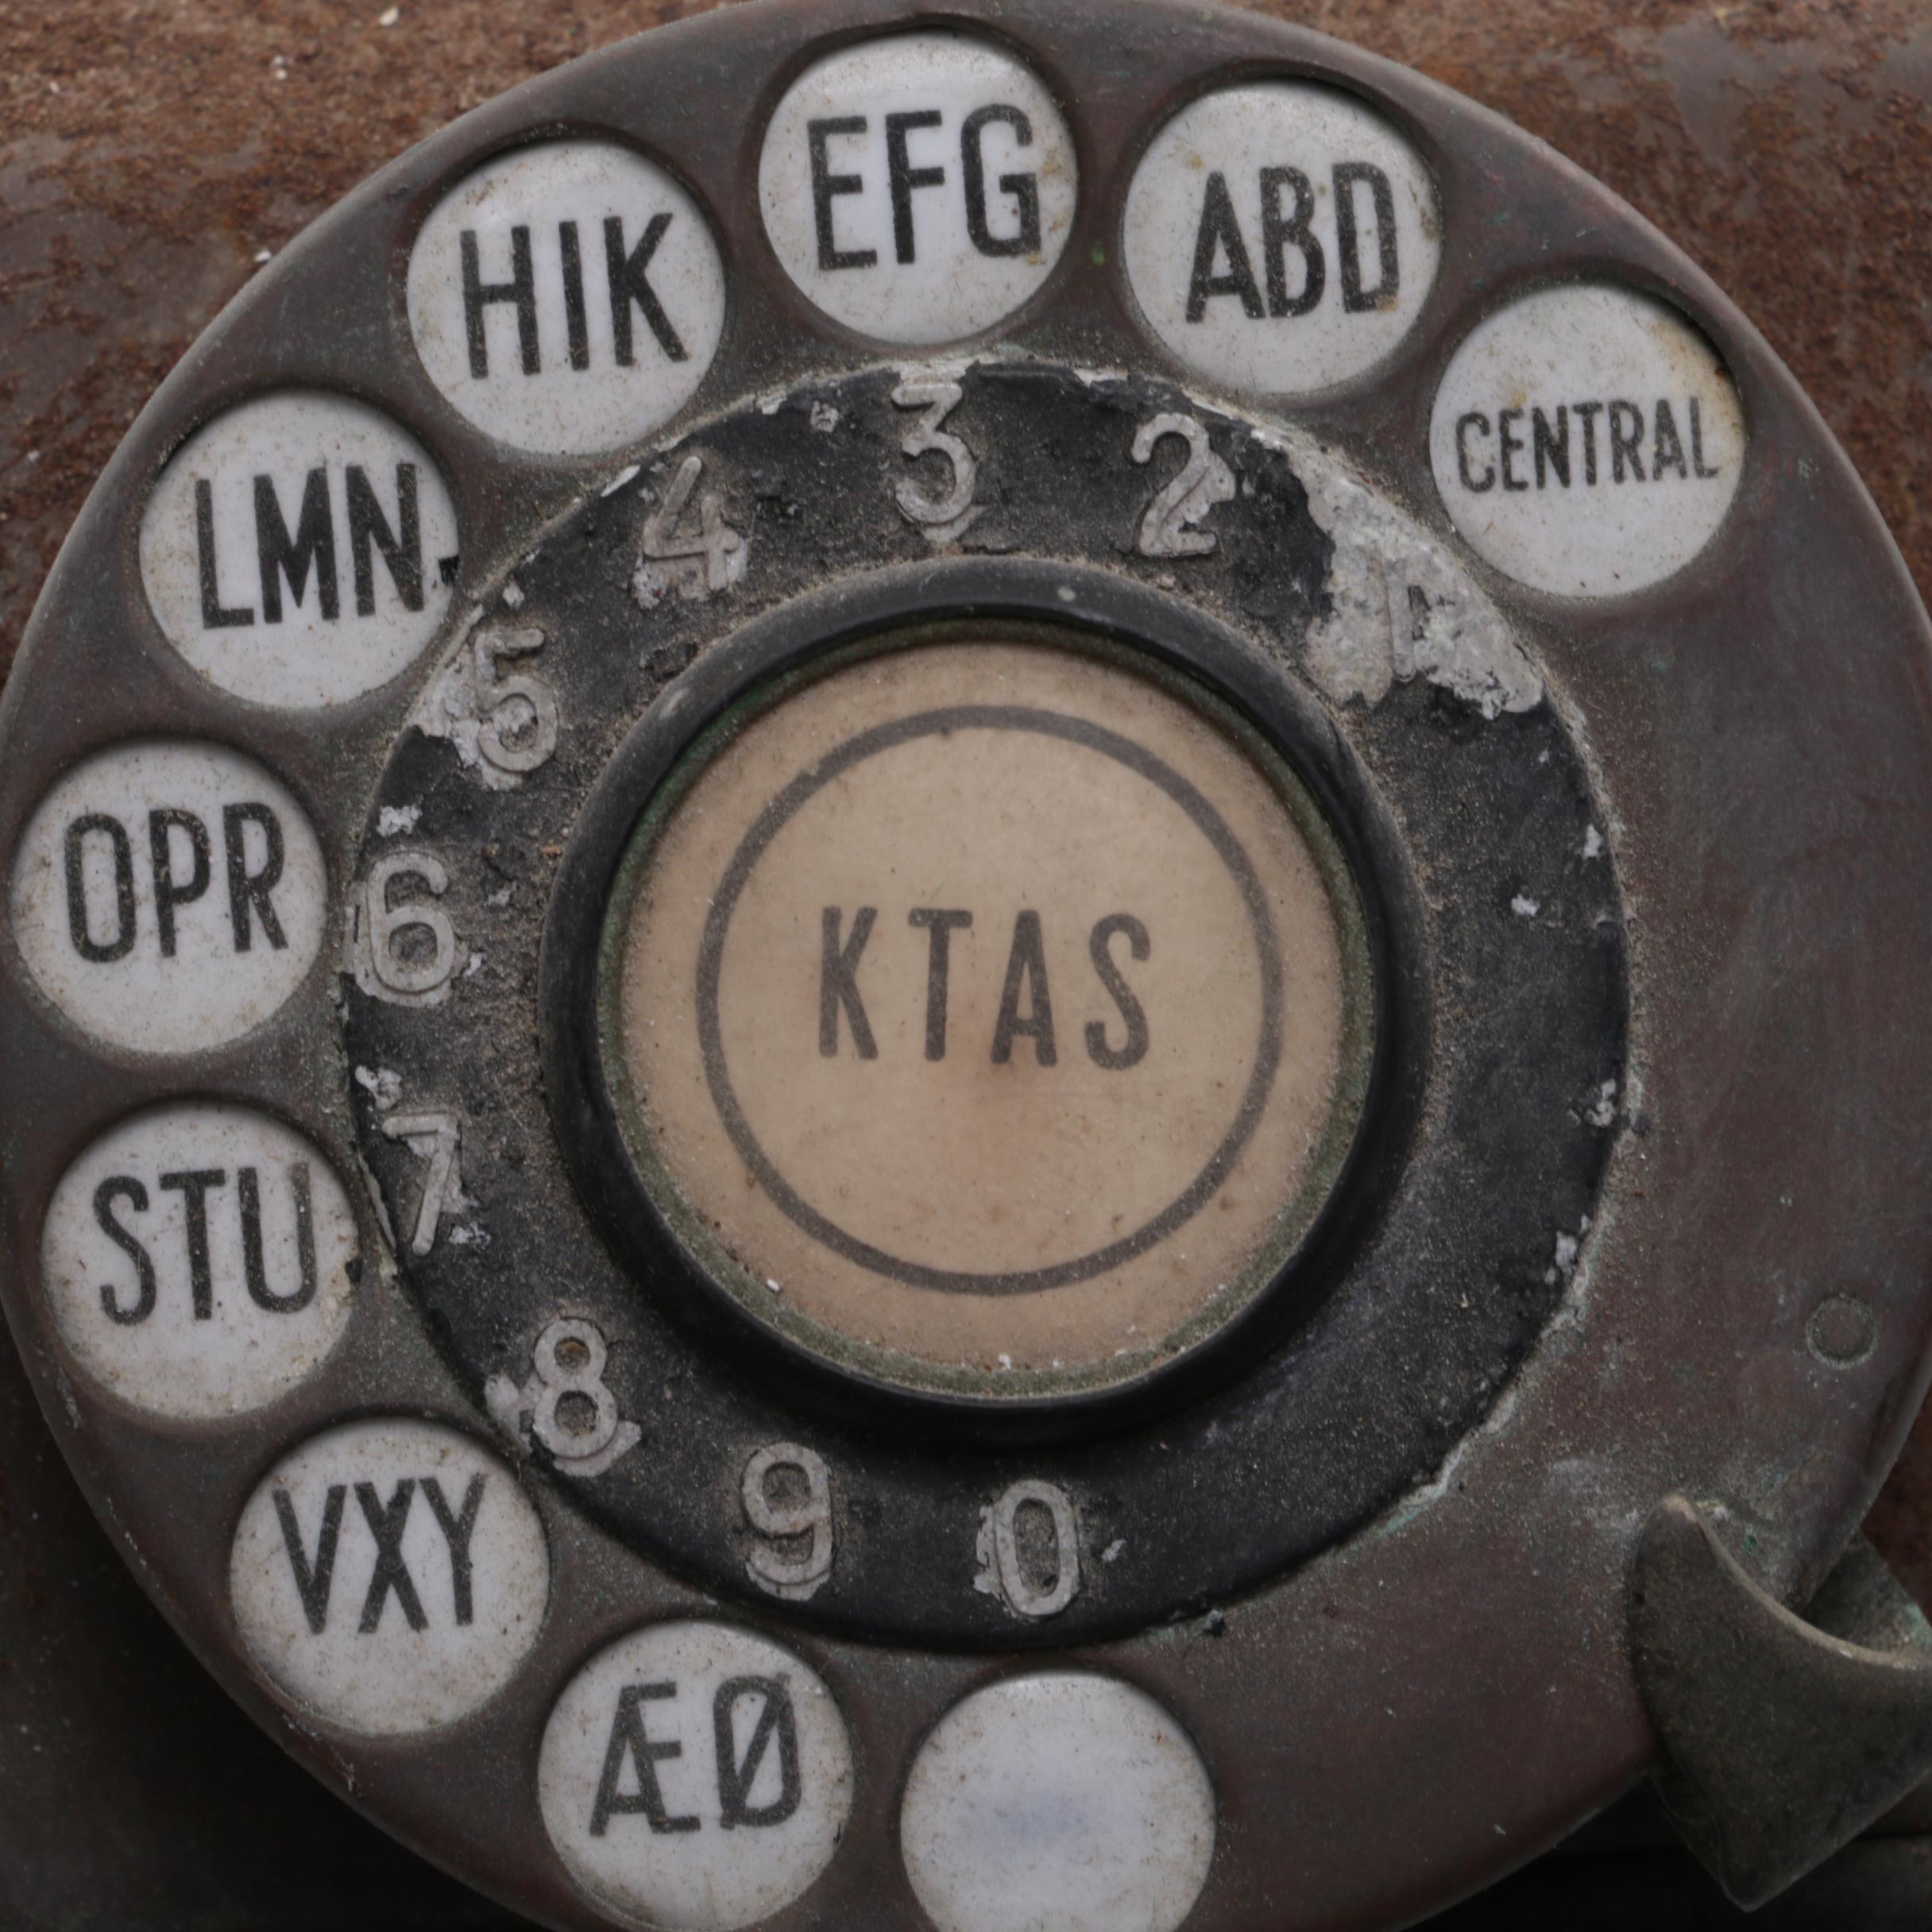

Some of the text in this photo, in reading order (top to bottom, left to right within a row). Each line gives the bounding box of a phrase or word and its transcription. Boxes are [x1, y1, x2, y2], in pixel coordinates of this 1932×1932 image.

[808, 106, 1042, 270] EFG
[1186, 162, 1400, 322] ABD
[461, 212, 688, 378] HIK
[891, 383, 977, 527] 3
[1133, 413, 1227, 558] 2
[1457, 397, 1718, 492] CENTRAL
[195, 461, 425, 627] LMN
[642, 455, 743, 593] 4
[475, 624, 559, 772] 5
[67, 803, 289, 961] OPR
[367, 856, 456, 993] 6
[820, 906, 1151, 1069] KTAS
[94, 1163, 316, 1322] STU
[384, 1115, 462, 1252] 7
[534, 1316, 618, 1459] 8
[273, 1474, 485, 1635] VXY
[744, 1444, 832, 1586] 9
[589, 1677, 802, 1837] ÆØ
